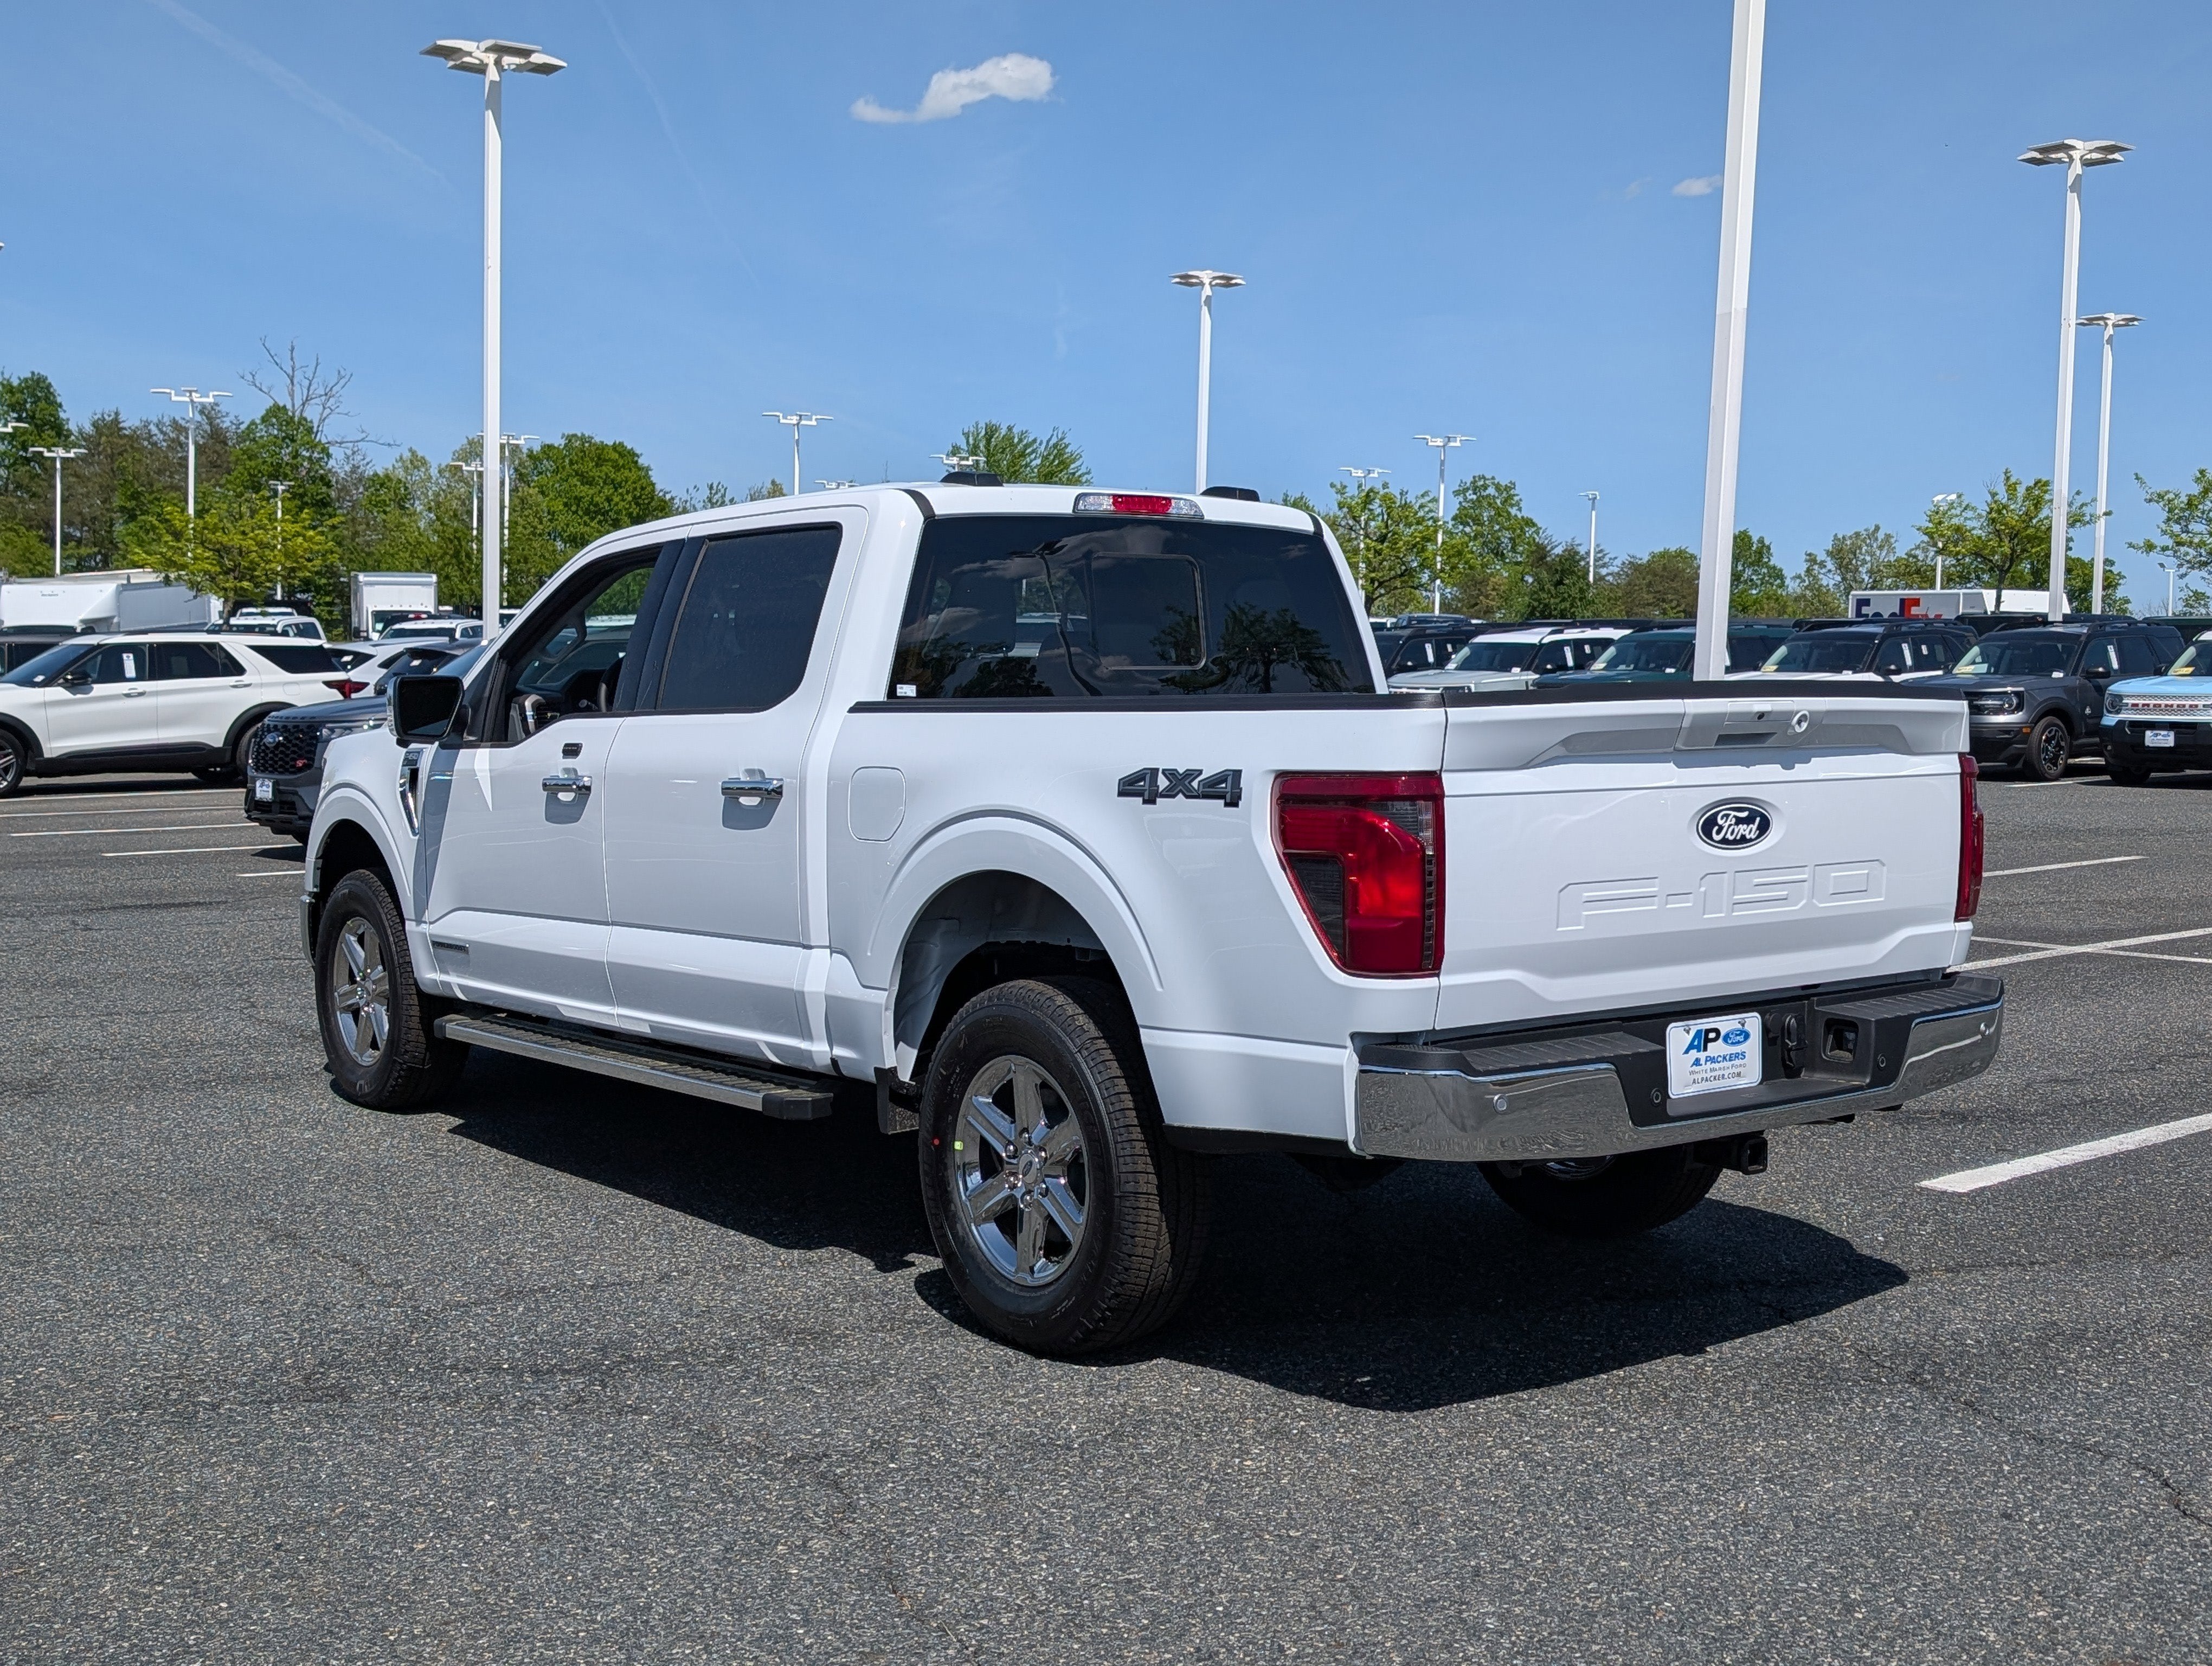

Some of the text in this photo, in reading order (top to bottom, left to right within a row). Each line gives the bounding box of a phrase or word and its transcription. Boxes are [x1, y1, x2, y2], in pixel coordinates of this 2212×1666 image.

[1712, 810, 1761, 841] Ford
[1556, 859, 1887, 931] F-150
[1682, 1027, 1721, 1055] AP
[1727, 1031, 1745, 1043] Ford
[1689, 1050, 1746, 1068] AL PACKER'S
